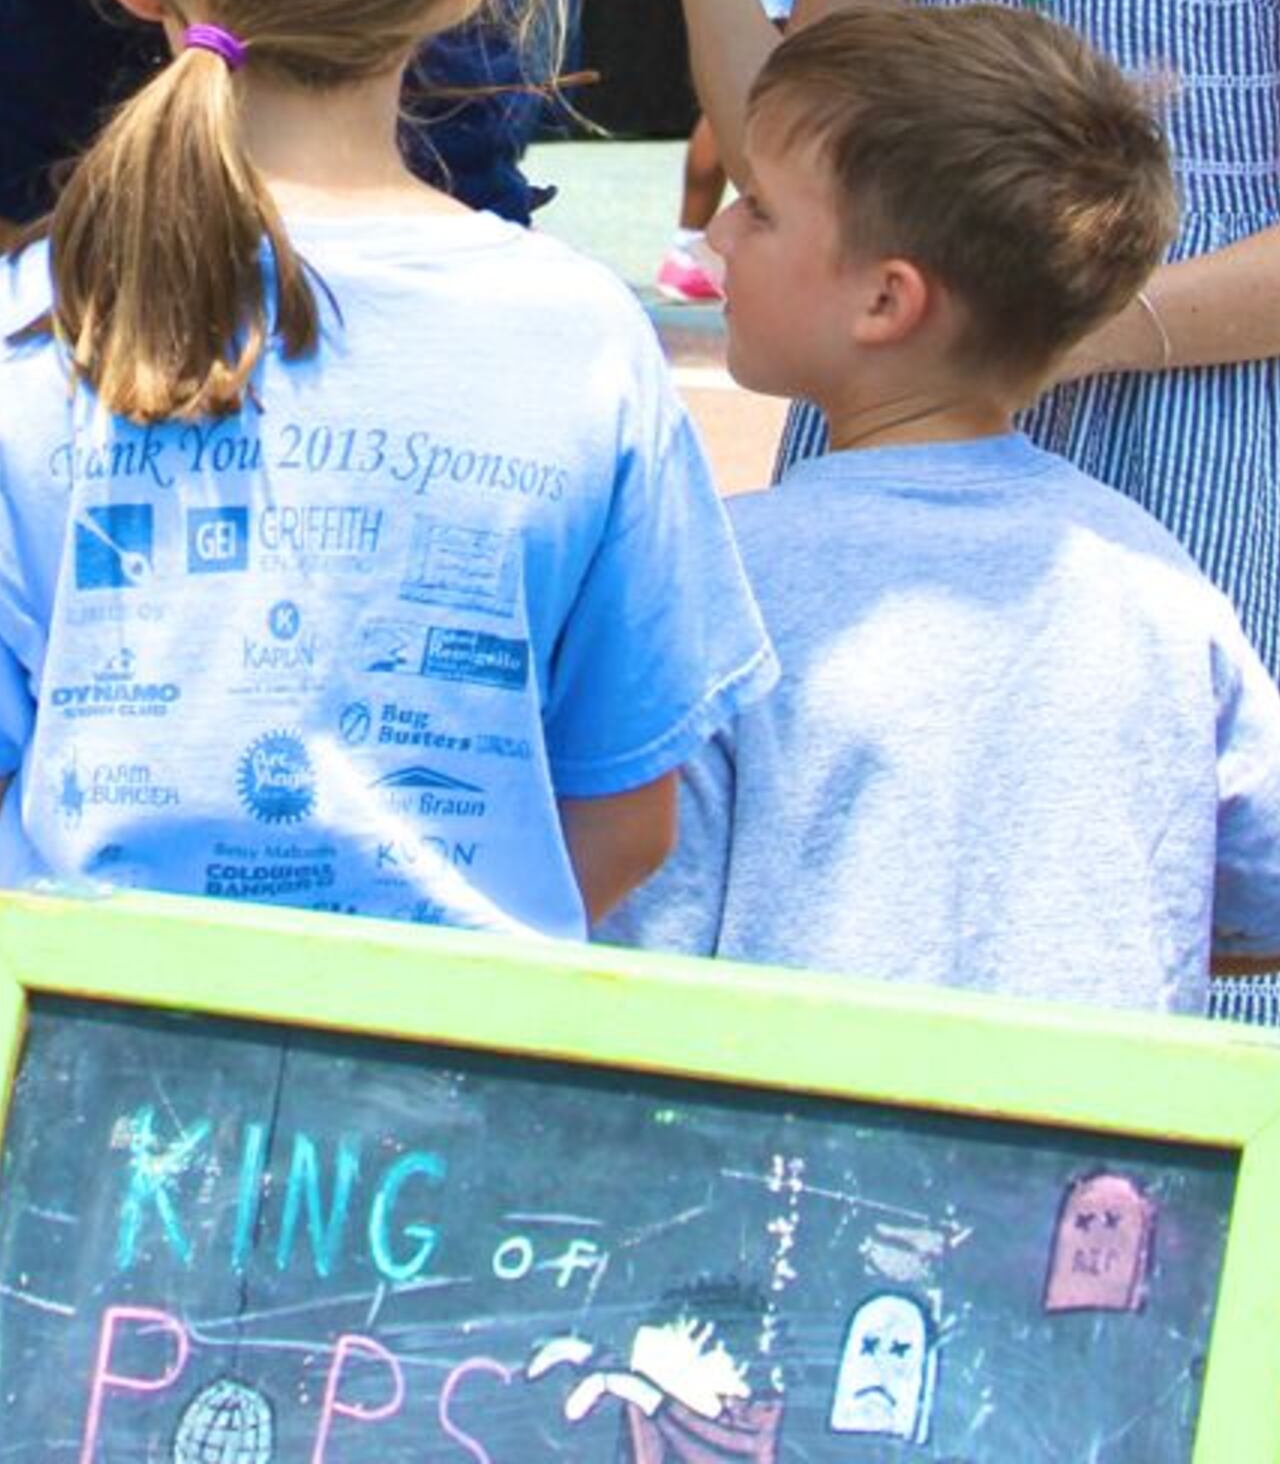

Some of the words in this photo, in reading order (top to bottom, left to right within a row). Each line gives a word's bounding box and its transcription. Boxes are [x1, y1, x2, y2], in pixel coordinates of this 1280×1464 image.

[179, 423, 262, 472] You
[278, 422, 388, 472] 2013
[391, 431, 570, 502] Sponsors
[195, 520, 237, 560] GEI
[259, 505, 384, 552] GRIFFITH
[381, 704, 429, 730] Bug
[379, 726, 472, 750] Busters
[420, 792, 485, 817] Braun
[118, 1106, 447, 1280] KING
